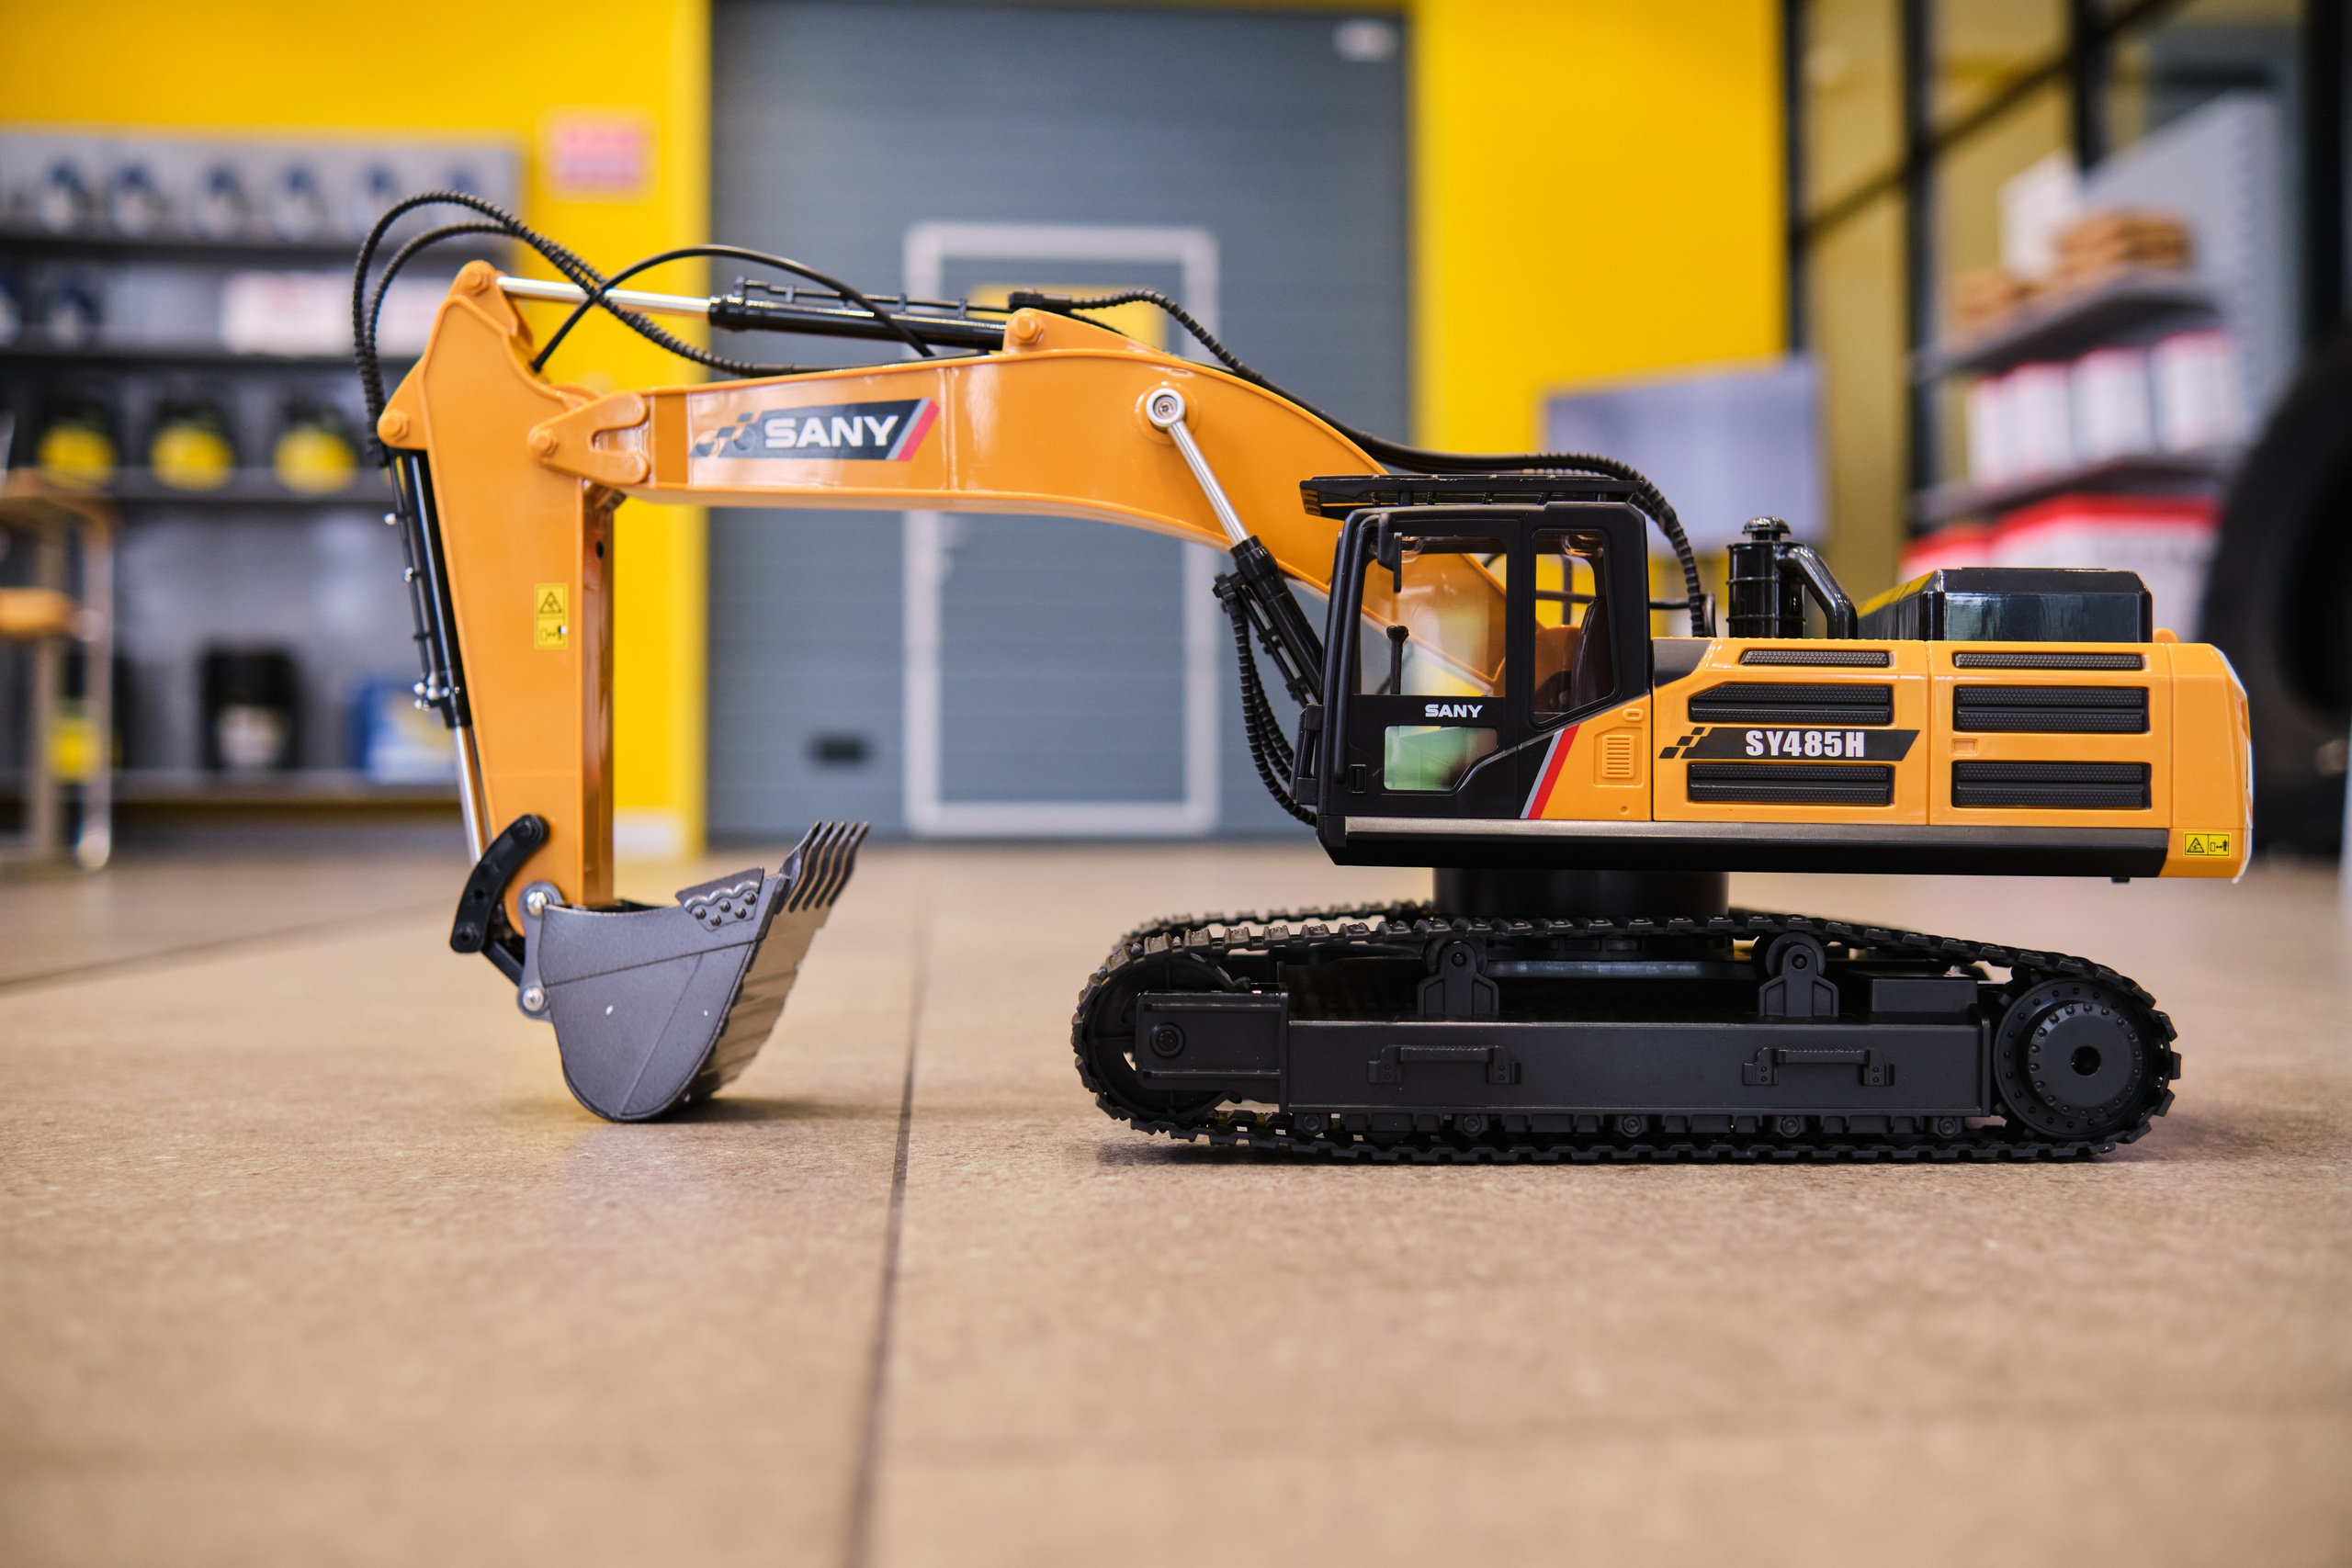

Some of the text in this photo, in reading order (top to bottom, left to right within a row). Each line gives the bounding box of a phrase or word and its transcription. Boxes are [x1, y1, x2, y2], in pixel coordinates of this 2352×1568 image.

[764, 415, 899, 448] SANY
[1424, 704, 1483, 717] SANY
[1746, 729, 1865, 758] SY485H
